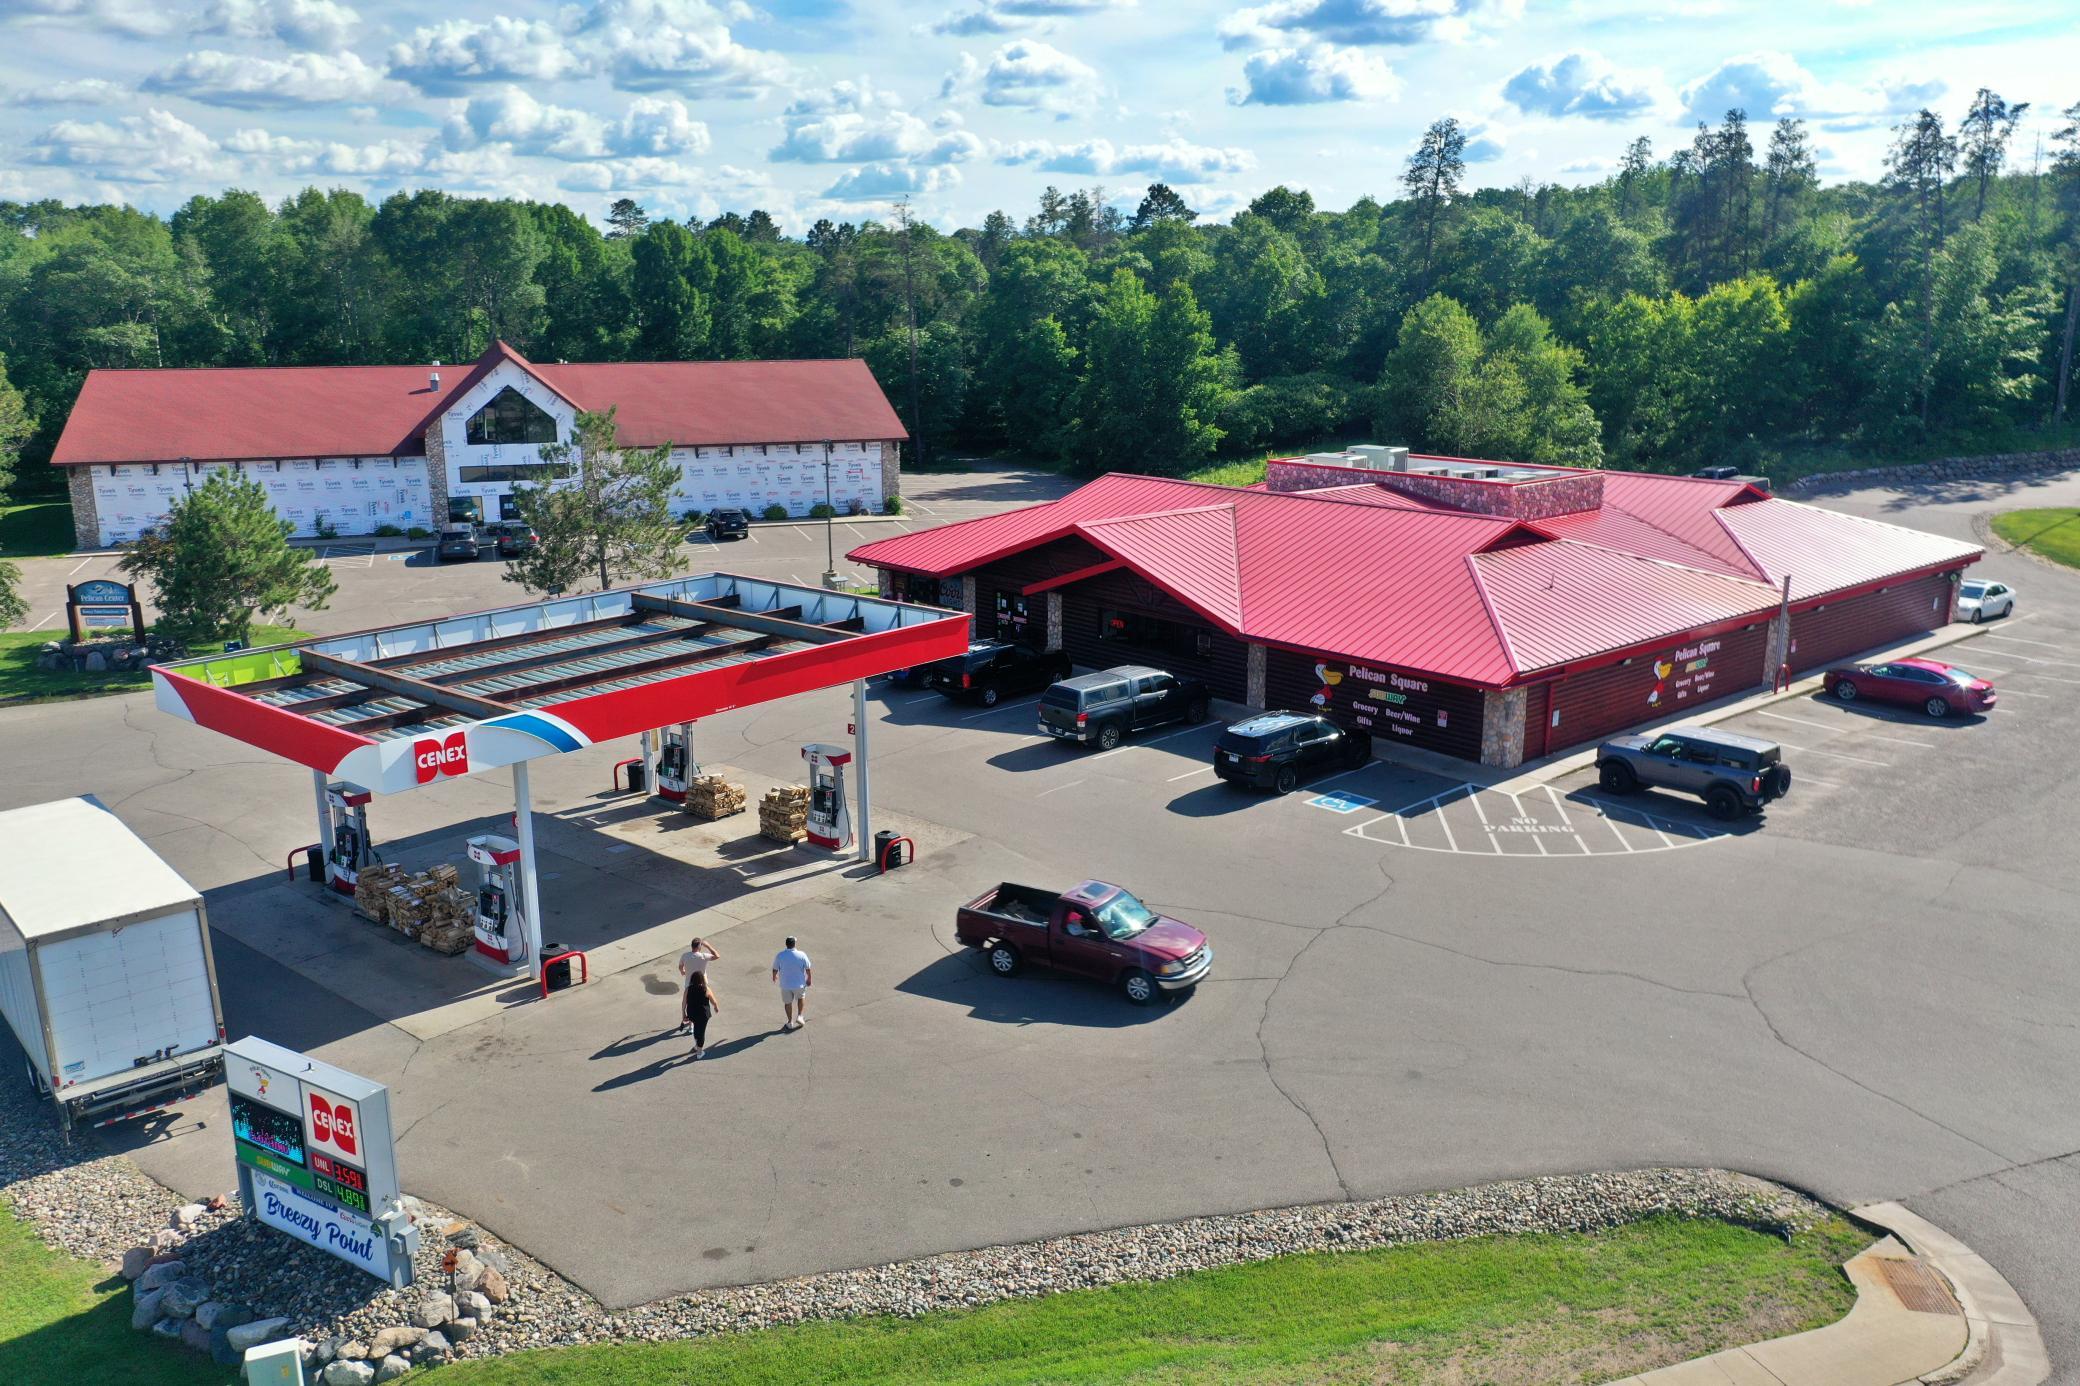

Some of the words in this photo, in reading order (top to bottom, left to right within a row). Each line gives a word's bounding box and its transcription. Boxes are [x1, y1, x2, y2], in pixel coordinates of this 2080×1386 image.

[1675, 648, 1698, 662] Pelican
[1350, 665, 1386, 684] Pelican
[1390, 674, 1428, 692] Square
[1353, 701, 1378, 715] Grocery
[1386, 708, 1421, 724] Beer/Wine
[850, 726, 855, 734] 2
[1357, 716, 1372, 726] Gifts
[1392, 724, 1413, 736] Liquor
[418, 745, 465, 768] CENEX
[313, 1109, 353, 1138] CENEX
[256, 1156, 290, 1176] SUBWAY
[314, 1156, 330, 1172] UNL
[317, 1178, 332, 1192] DSL
[264, 1192, 321, 1240] Breezy
[326, 1222, 373, 1260] Point
